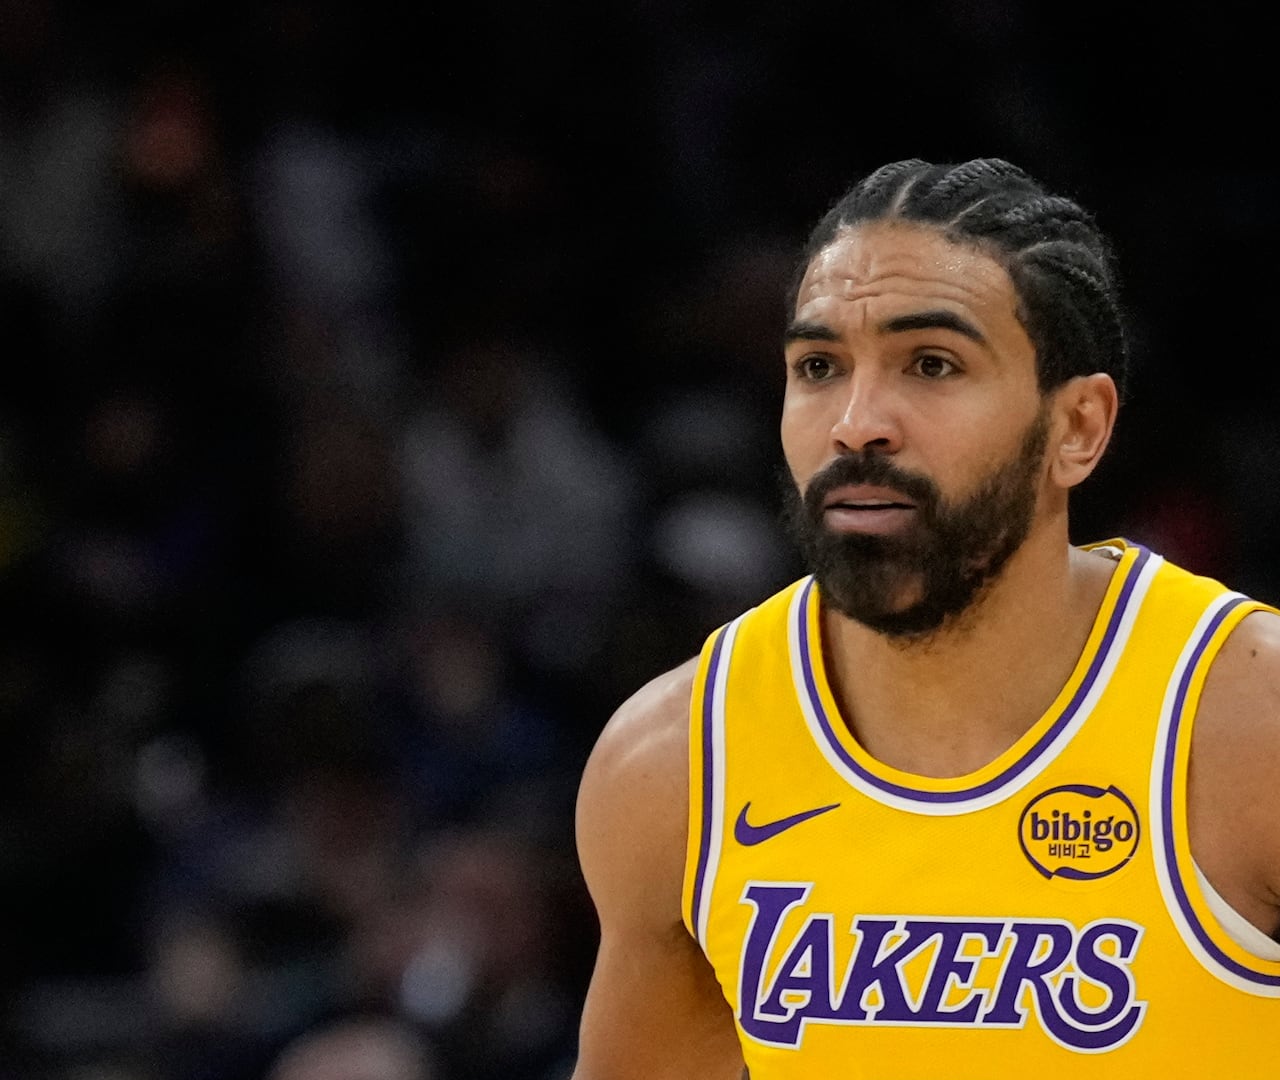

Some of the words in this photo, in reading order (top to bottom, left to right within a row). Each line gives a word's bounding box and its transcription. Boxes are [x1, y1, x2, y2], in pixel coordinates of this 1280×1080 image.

[1031, 810, 1133, 852] bibigo
[1048, 843, 1091, 859] 비비고
[737, 881, 1147, 1054] LAKERS
